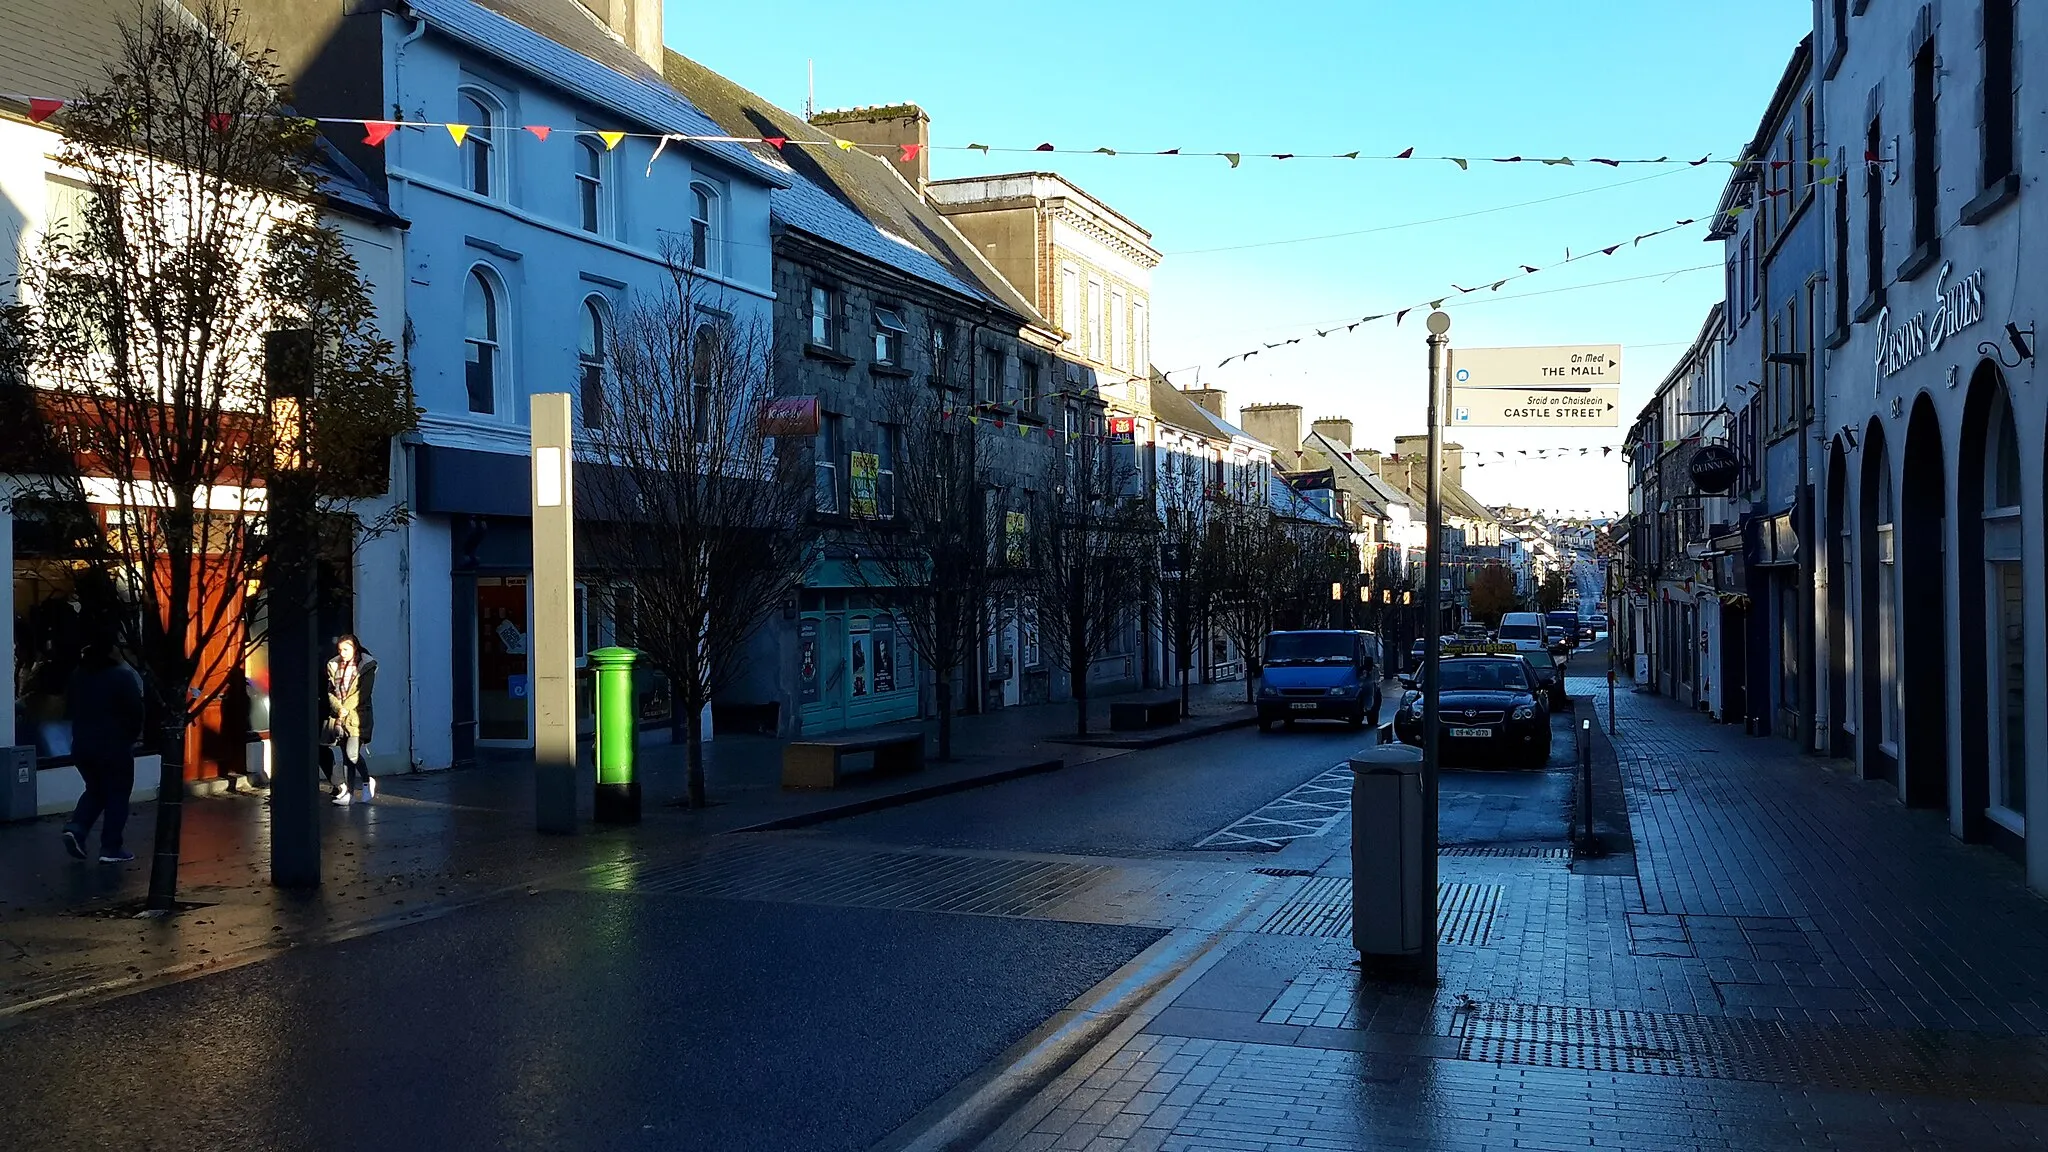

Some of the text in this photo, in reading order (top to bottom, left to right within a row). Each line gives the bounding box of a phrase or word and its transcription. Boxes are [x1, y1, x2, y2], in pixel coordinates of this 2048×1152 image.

[1874, 259, 1985, 400] PARSONS SHOES
[1541, 366, 1605, 377] THE MALL
[1550, 397, 1560, 405] an
[1504, 408, 1603, 418] CASTLE STREET
[1116, 433, 1130, 441] AIB
[1692, 460, 1735, 474] GUINNESS
[1463, 644, 1486, 653] TAXI
